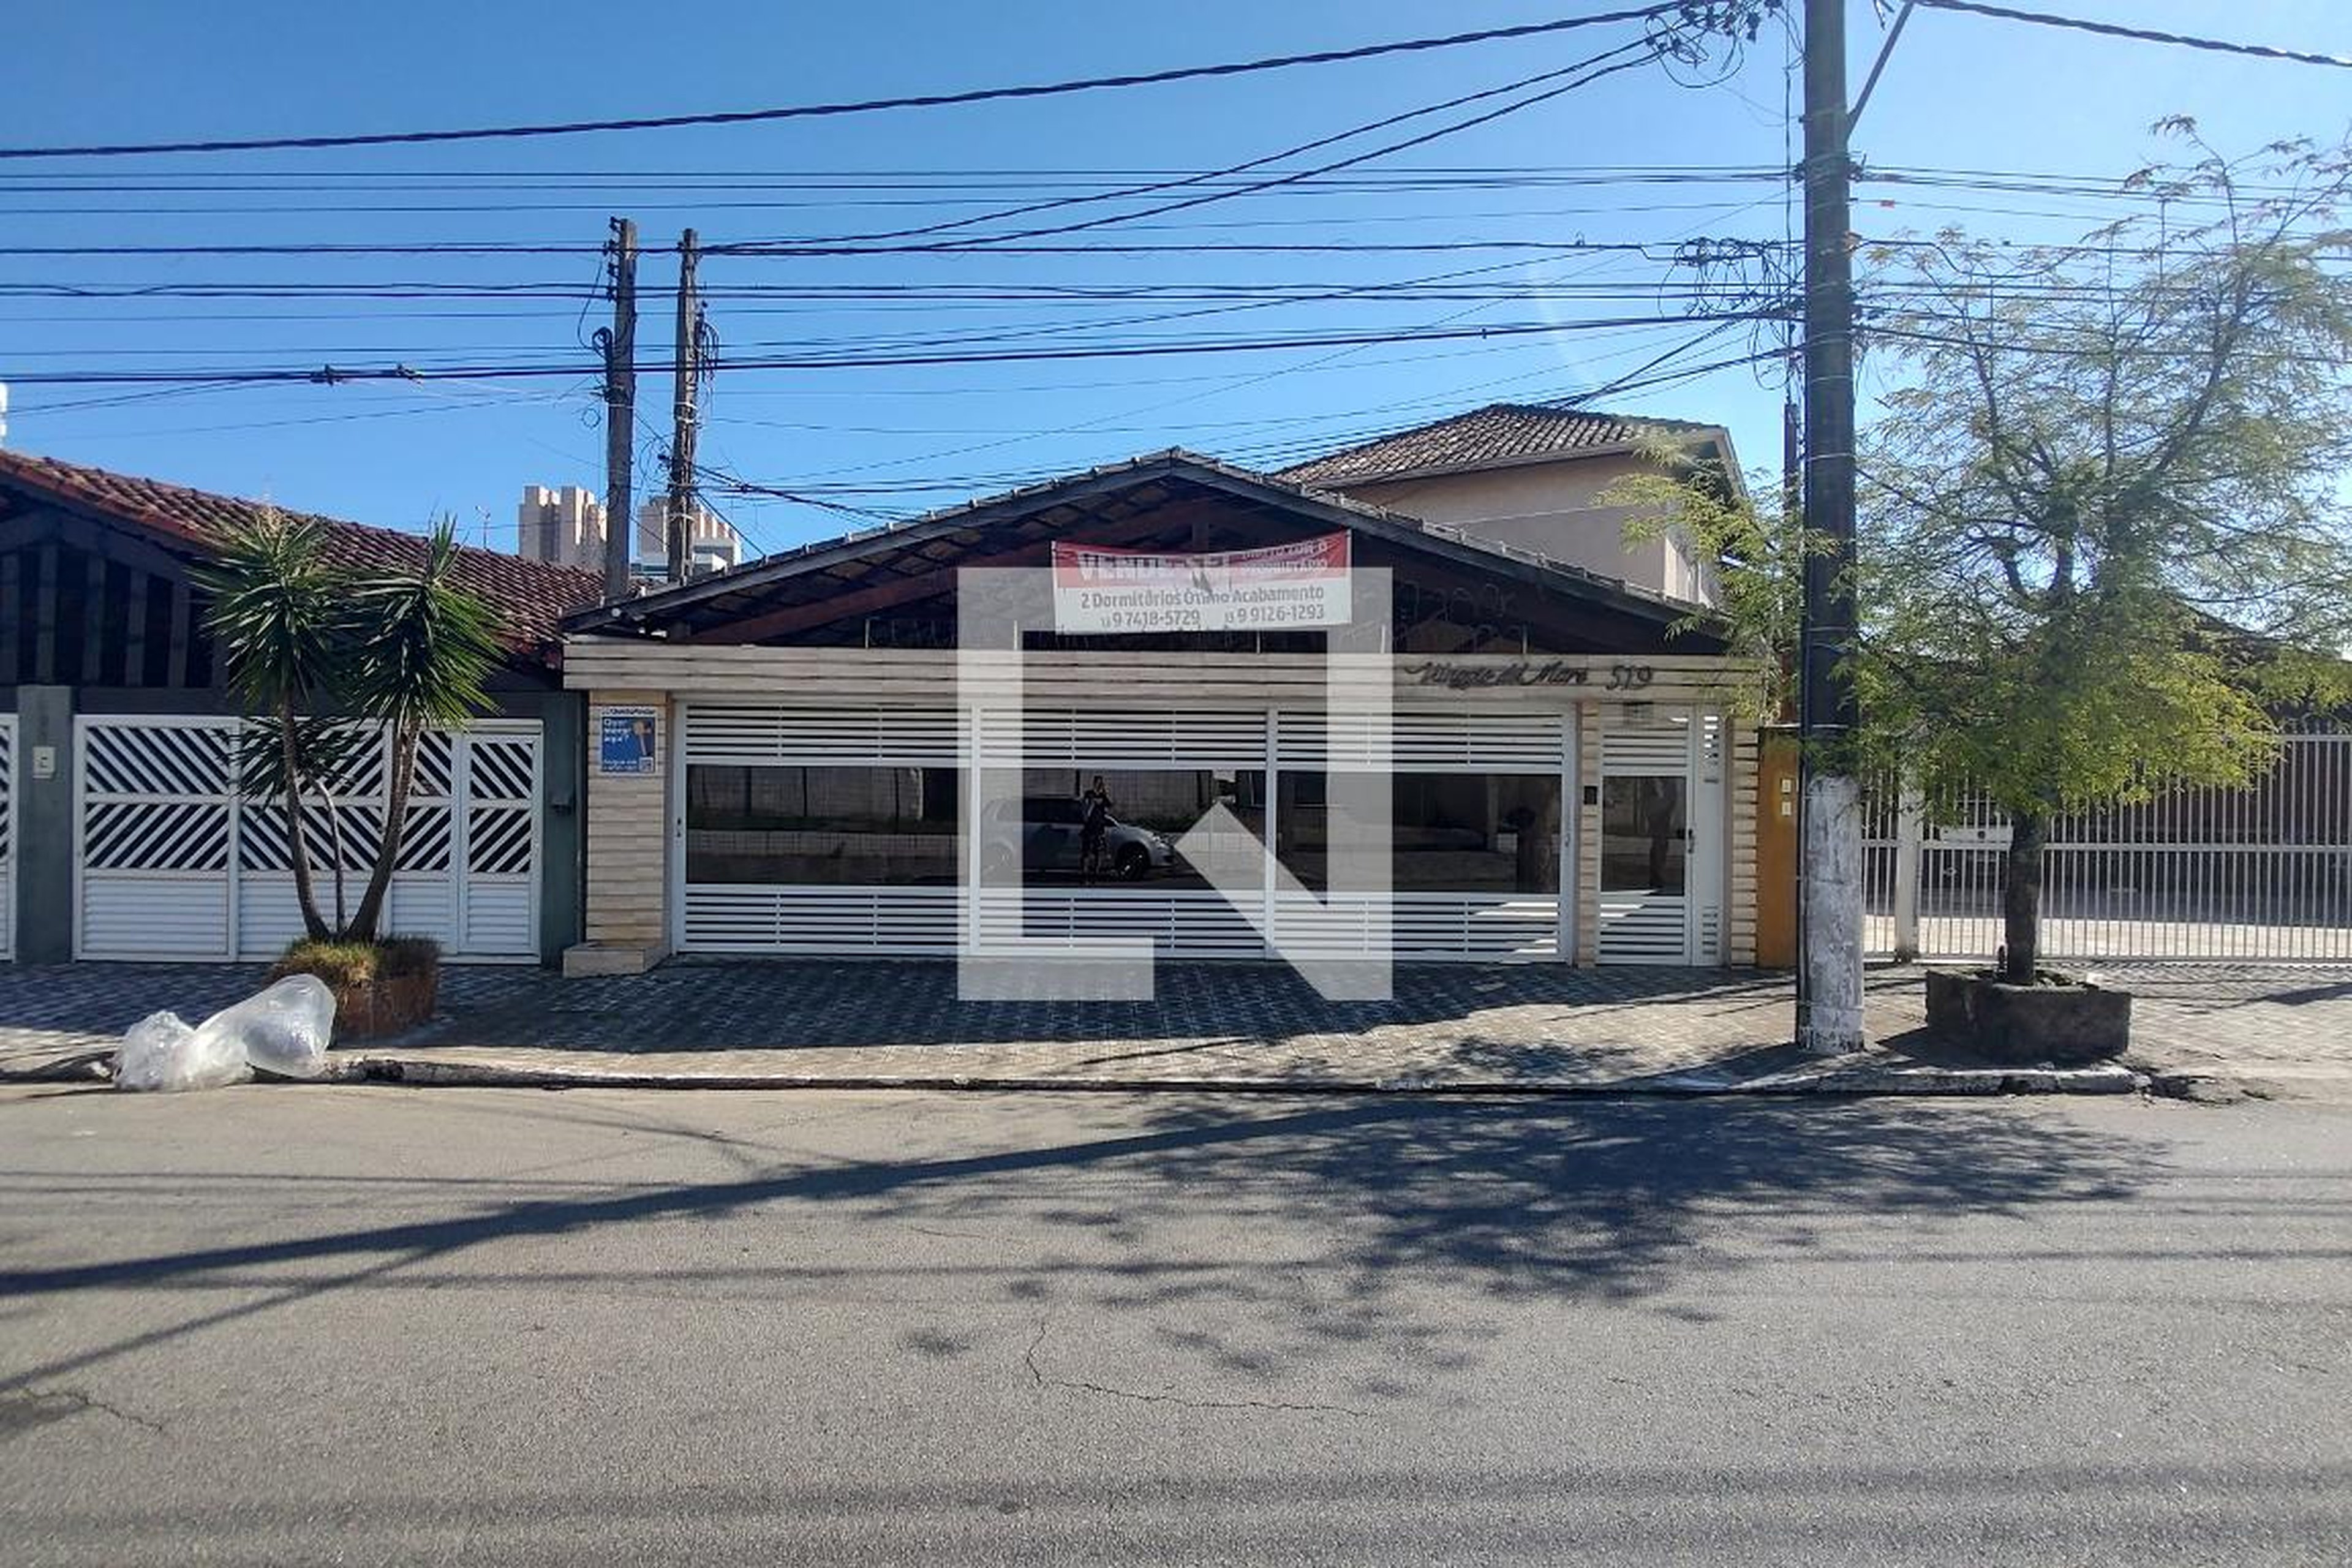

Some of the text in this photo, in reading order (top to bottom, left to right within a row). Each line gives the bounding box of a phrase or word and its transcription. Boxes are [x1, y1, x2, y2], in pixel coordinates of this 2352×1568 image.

[1080, 592, 1090, 609] 2
[1093, 587, 1182, 608] Dormitórios
[1232, 584, 1324, 604] Acabamento
